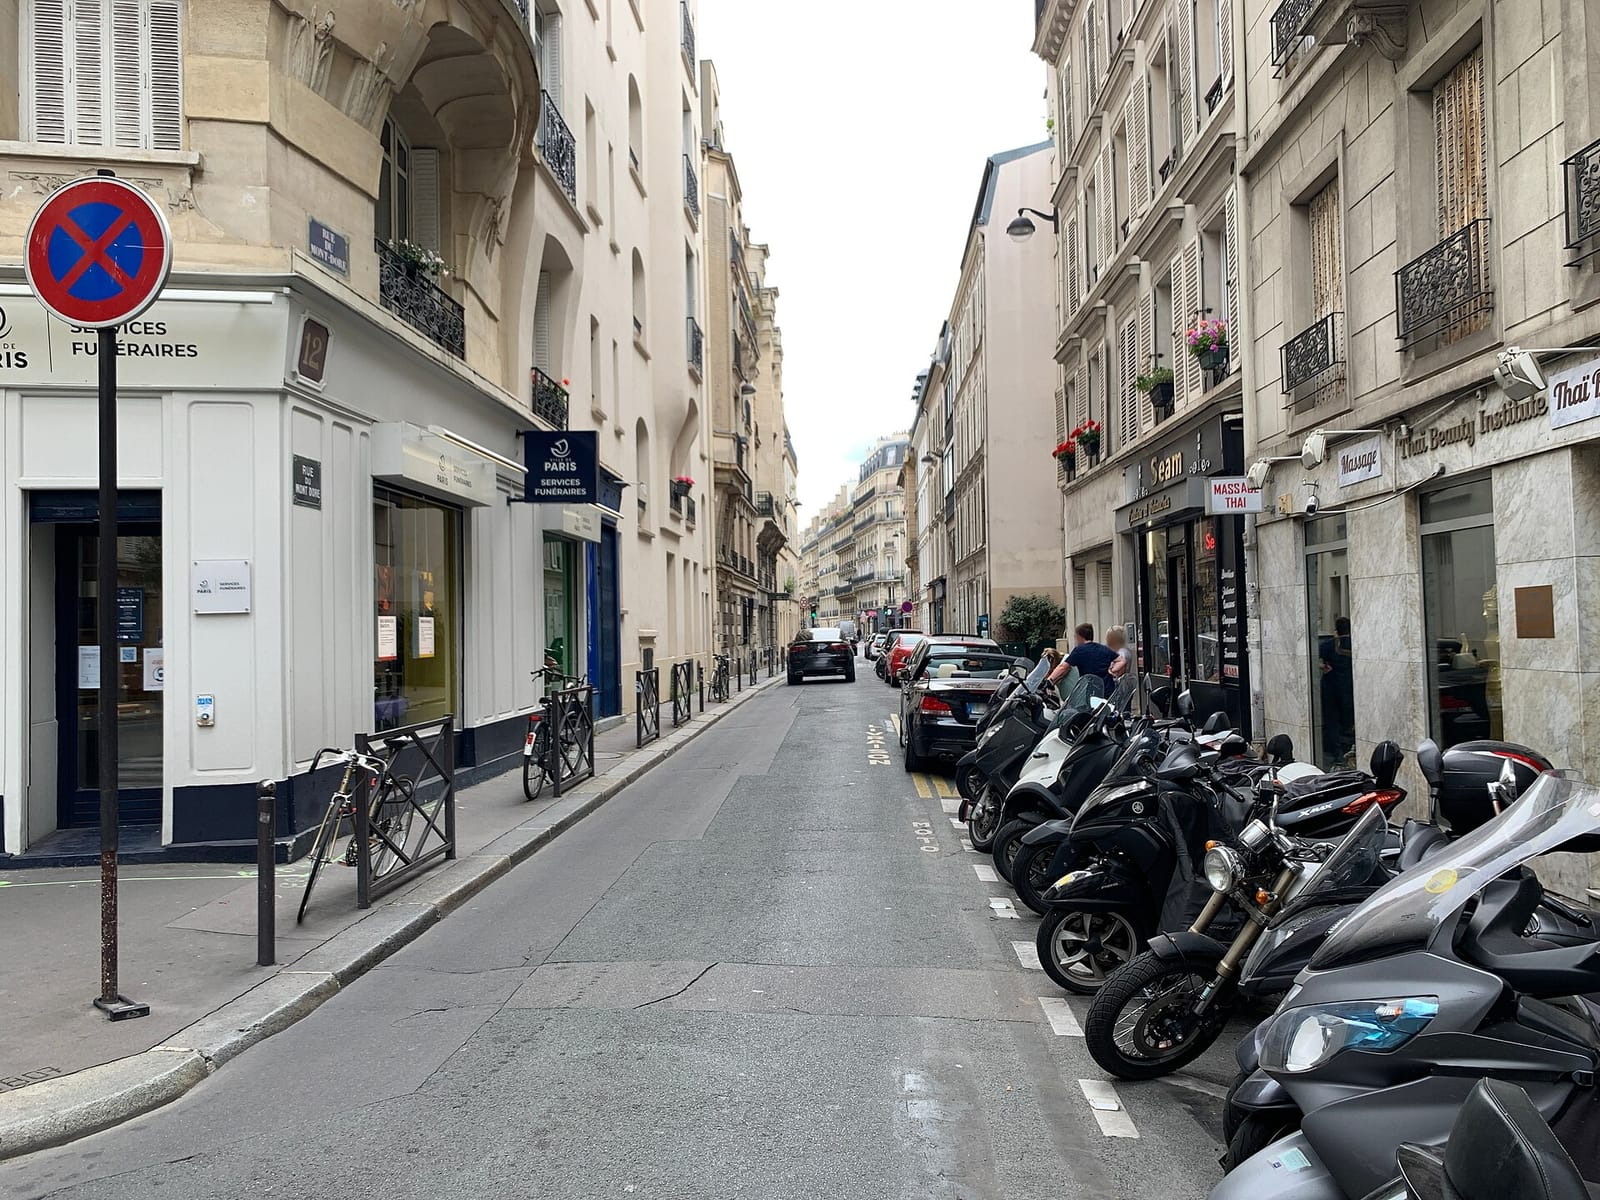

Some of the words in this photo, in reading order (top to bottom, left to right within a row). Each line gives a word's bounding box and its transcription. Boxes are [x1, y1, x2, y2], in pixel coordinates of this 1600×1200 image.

[322, 228, 336, 244] RUE
[71, 321, 167, 335] SEVICES
[72, 340, 198, 357] FUÉRAIRES
[302, 332, 323, 371] 12
[1554, 374, 1590, 410] Thaï
[1429, 417, 1475, 451] Beauty
[1479, 396, 1549, 435] Institute
[302, 464, 314, 477] RUE
[544, 462, 577, 471] PARIS
[1151, 451, 1183, 487] Seam
[1341, 450, 1377, 475] Massage
[534, 487, 587, 495] FUNÉRAIRES
[1225, 497, 1246, 508] THAI
